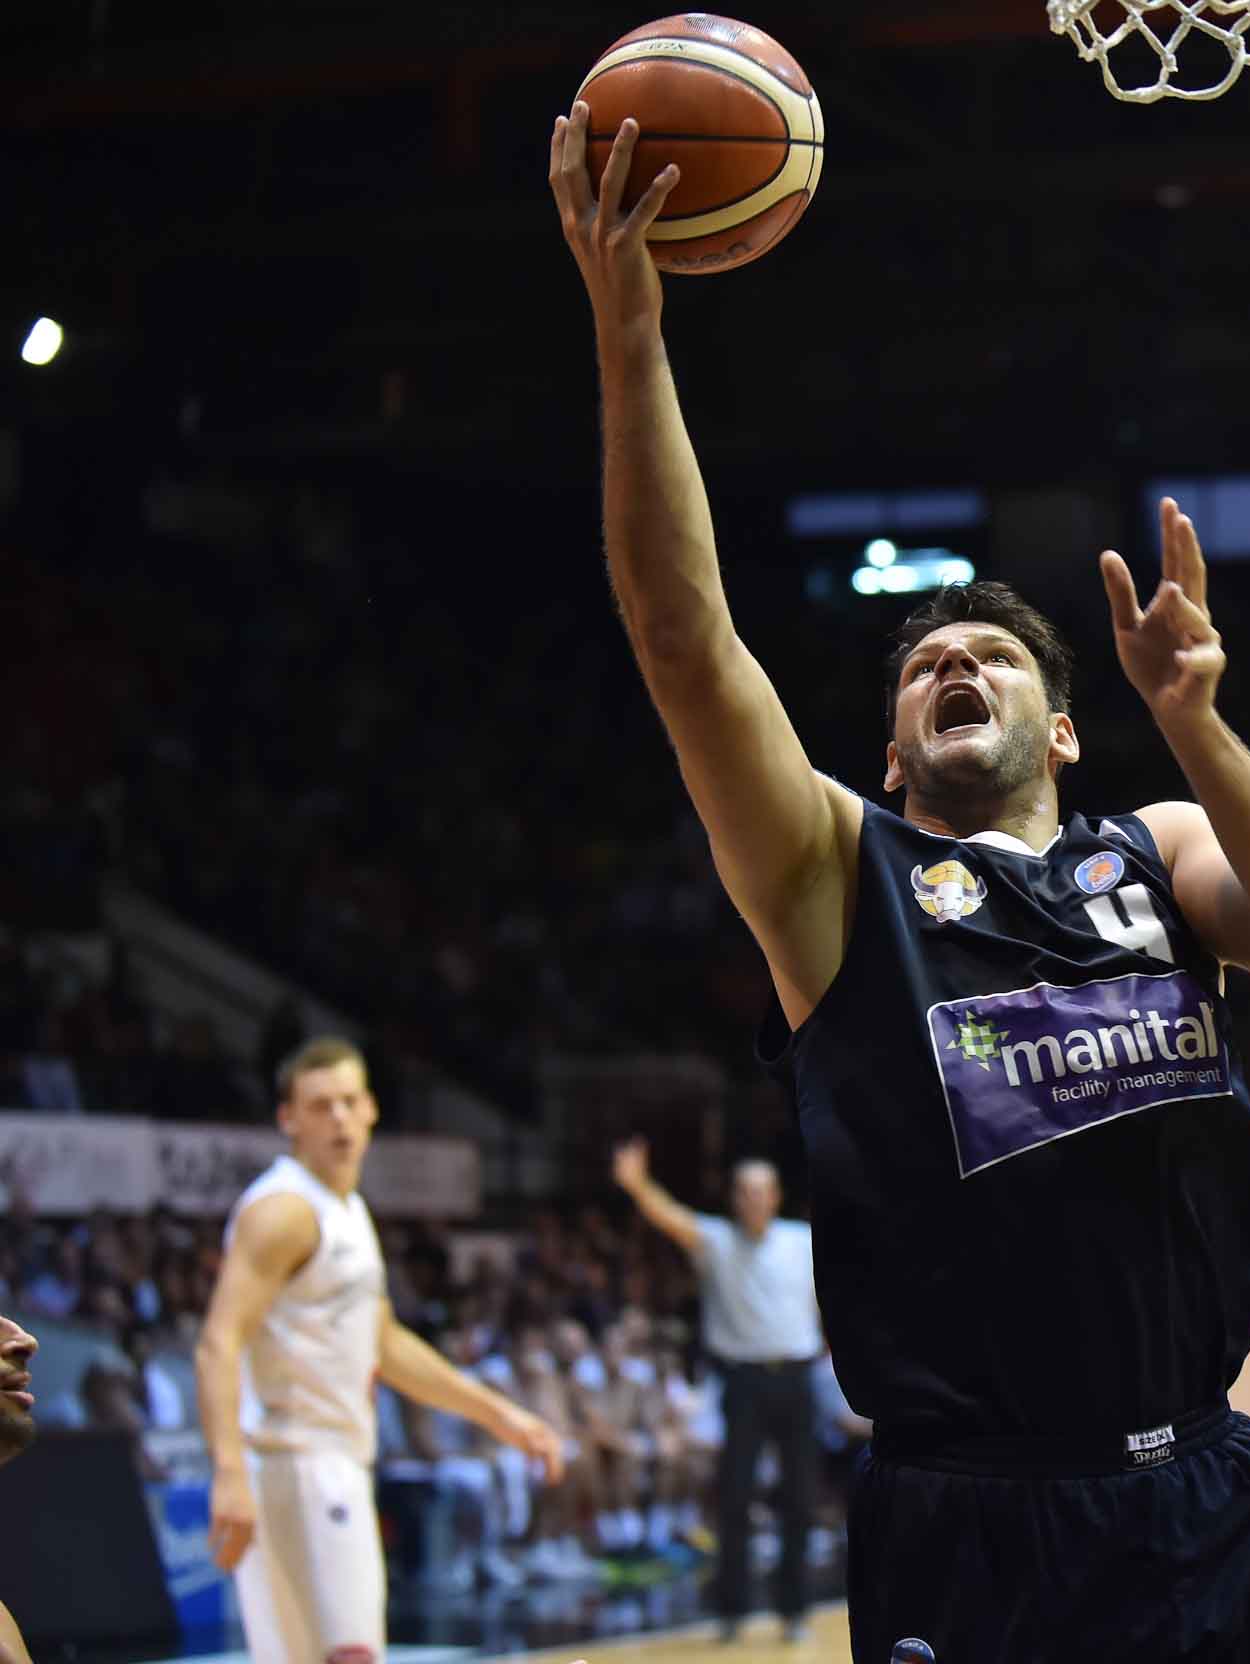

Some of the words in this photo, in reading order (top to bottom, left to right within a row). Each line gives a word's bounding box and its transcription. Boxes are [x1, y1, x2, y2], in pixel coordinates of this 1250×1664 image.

[1001, 1002, 1219, 1087] manital
[1051, 1081, 1110, 1103] facility
[1116, 1066, 1223, 1092] management
